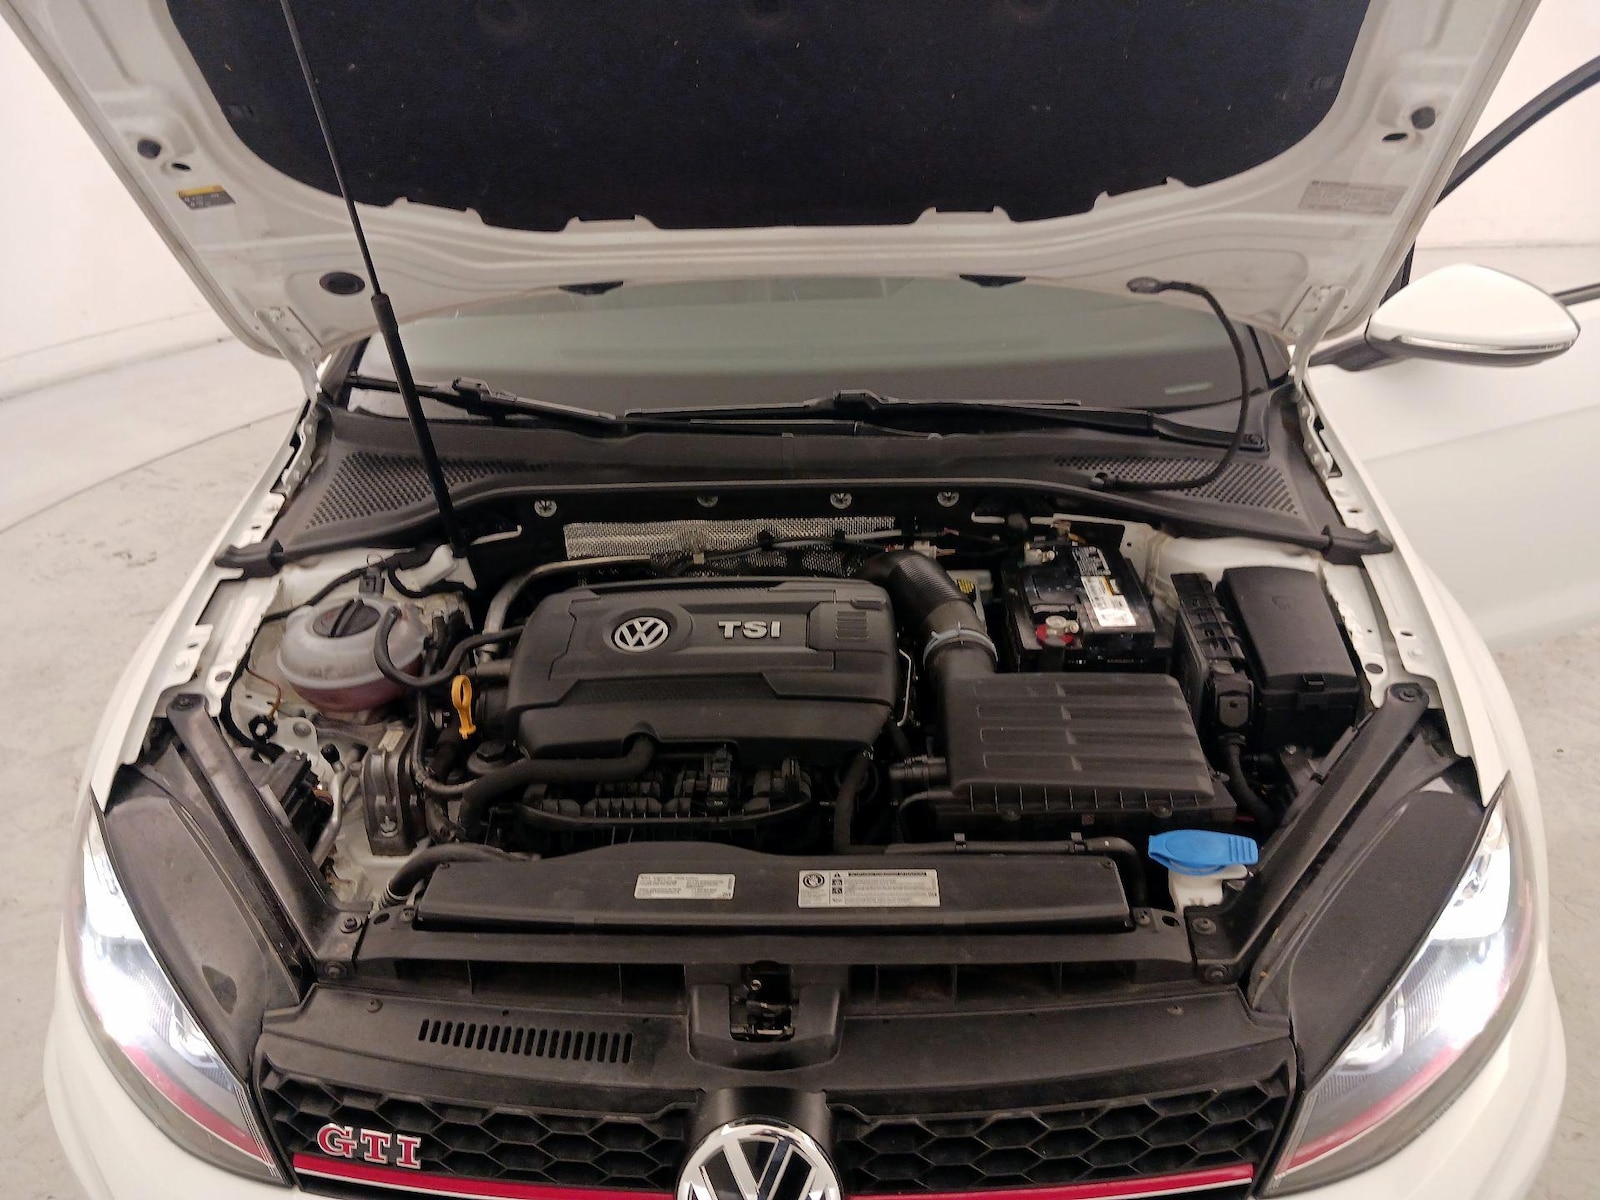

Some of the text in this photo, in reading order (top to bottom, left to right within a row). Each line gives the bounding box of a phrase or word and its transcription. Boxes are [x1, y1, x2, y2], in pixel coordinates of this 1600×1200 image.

[616, 617, 781, 652] VW TSI
[317, 1123, 421, 1169] GTI
